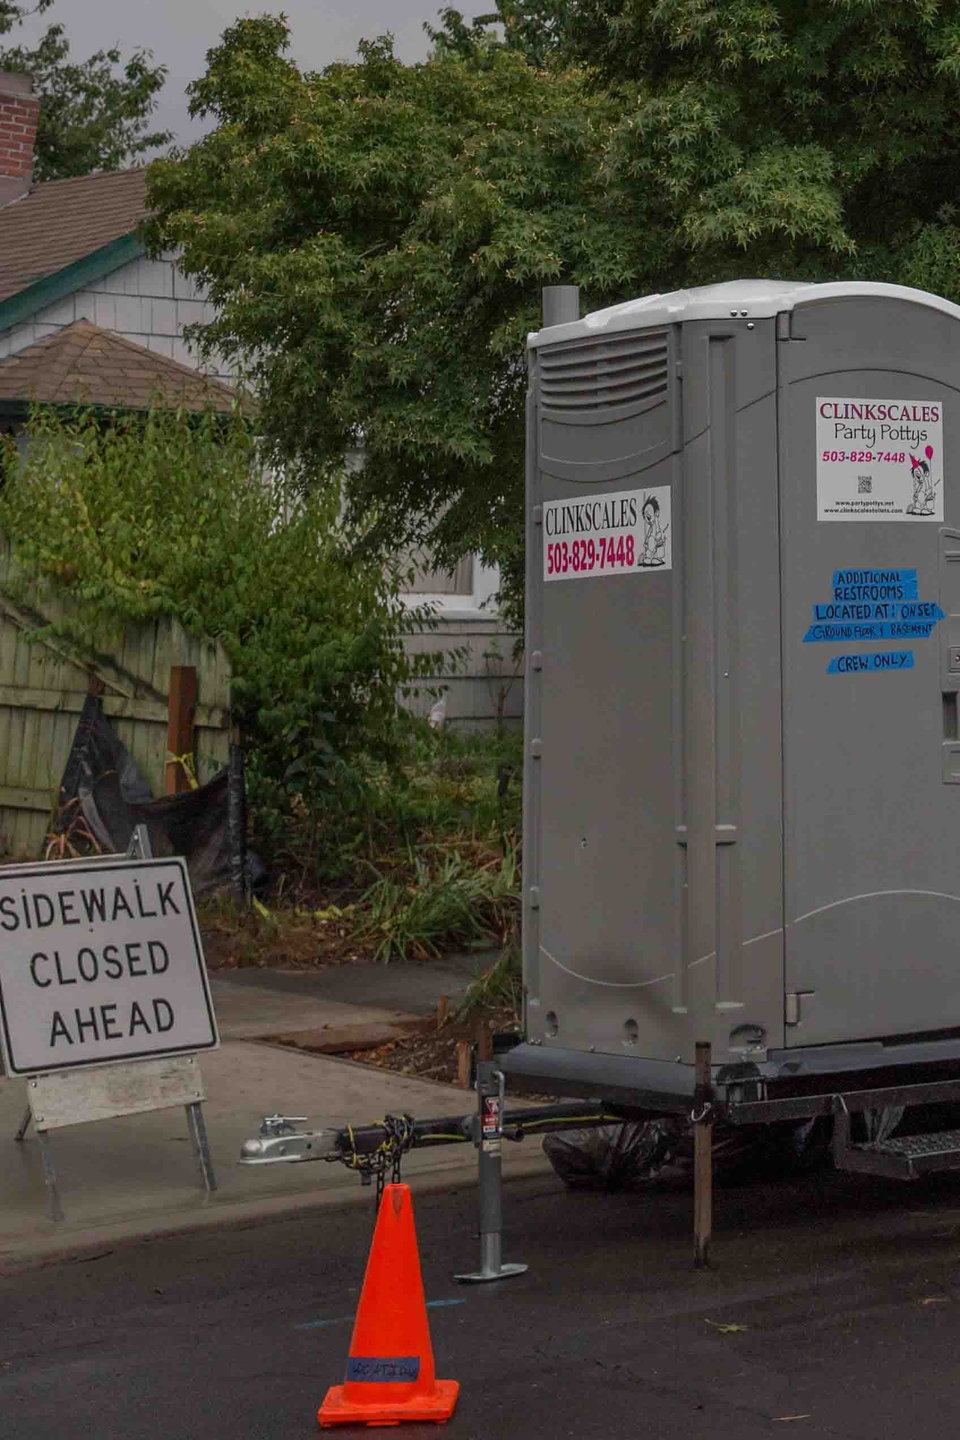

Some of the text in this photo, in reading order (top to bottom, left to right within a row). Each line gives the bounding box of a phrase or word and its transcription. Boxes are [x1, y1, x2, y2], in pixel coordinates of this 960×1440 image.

[819, 403, 940, 423] CLINKSCALES
[833, 422, 929, 450] Party Pottys
[822, 451, 906, 463] 503-829-7448
[545, 497, 638, 537] CLINKSCALES
[546, 534, 636, 575] 503-829-7448
[837, 570, 902, 585] ADDITIONAL
[834, 586, 904, 601] RESTROOMS
[815, 604, 871, 620] LOCATED
[811, 625, 853, 640] GROUND
[837, 654, 908, 673] CREW ONLY
[0, 881, 181, 932] SIDEWALK
[30, 940, 170, 988] CLOSED
[49, 997, 175, 1047] AHEAD
